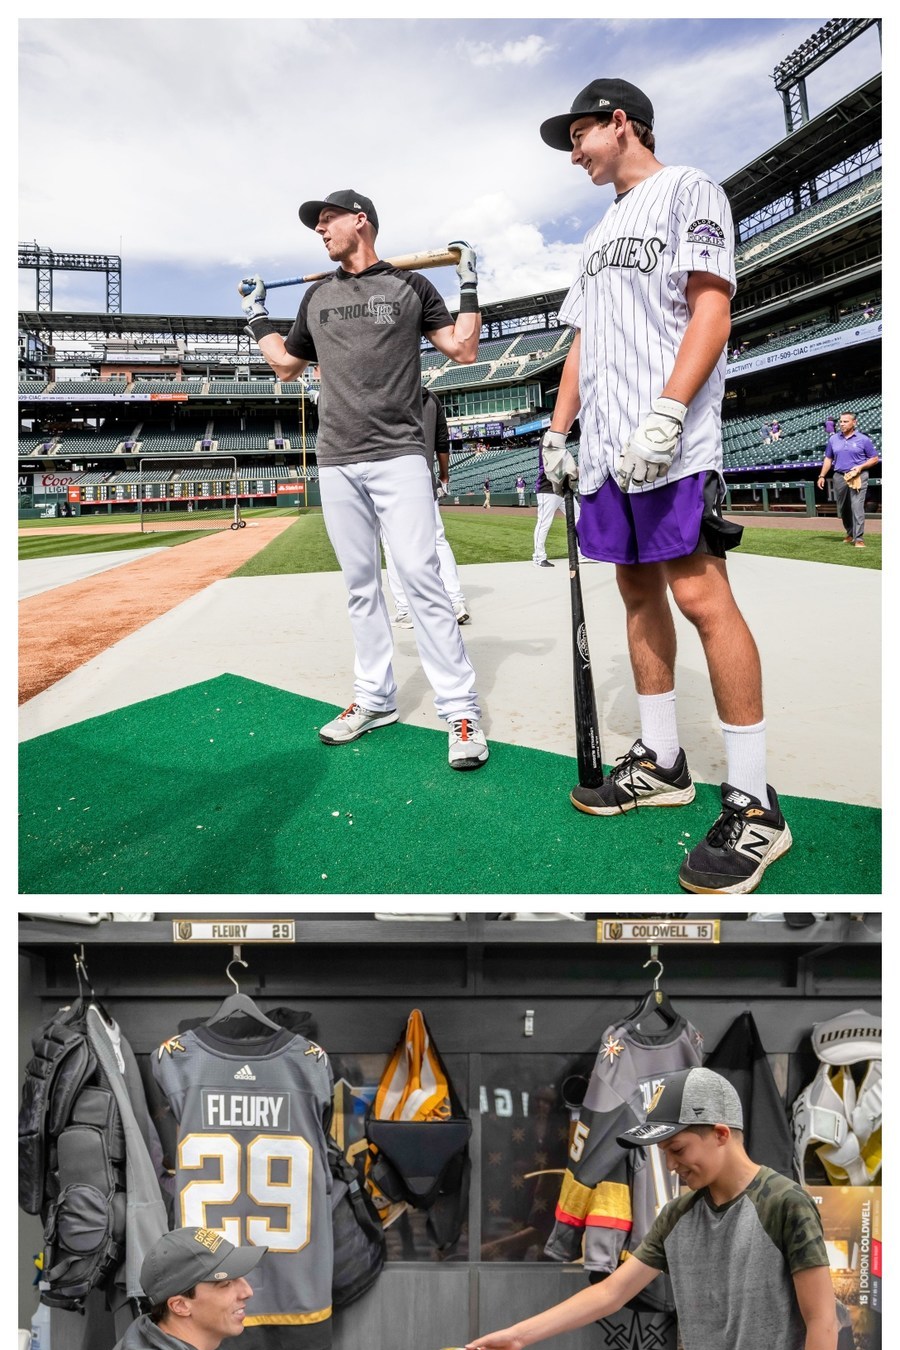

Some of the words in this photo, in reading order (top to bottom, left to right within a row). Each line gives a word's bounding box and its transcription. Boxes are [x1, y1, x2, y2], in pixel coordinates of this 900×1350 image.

[688, 233, 725, 246] ROCKIES
[732, 362, 753, 373] ACTIVITY
[767, 346, 809, 363] 877-509-CIAC
[212, 925, 248, 938] FLEURY
[272, 924, 290, 938] 29
[632, 926, 688, 937] COLDWELL
[697, 926, 708, 937] 15
[207, 1094, 284, 1128] FLEURY
[178, 1133, 314, 1253] 29
[861, 1200, 871, 1252] COLDWELL
[860, 1253, 870, 1288] DORON
[860, 1295, 868, 1305] 15
